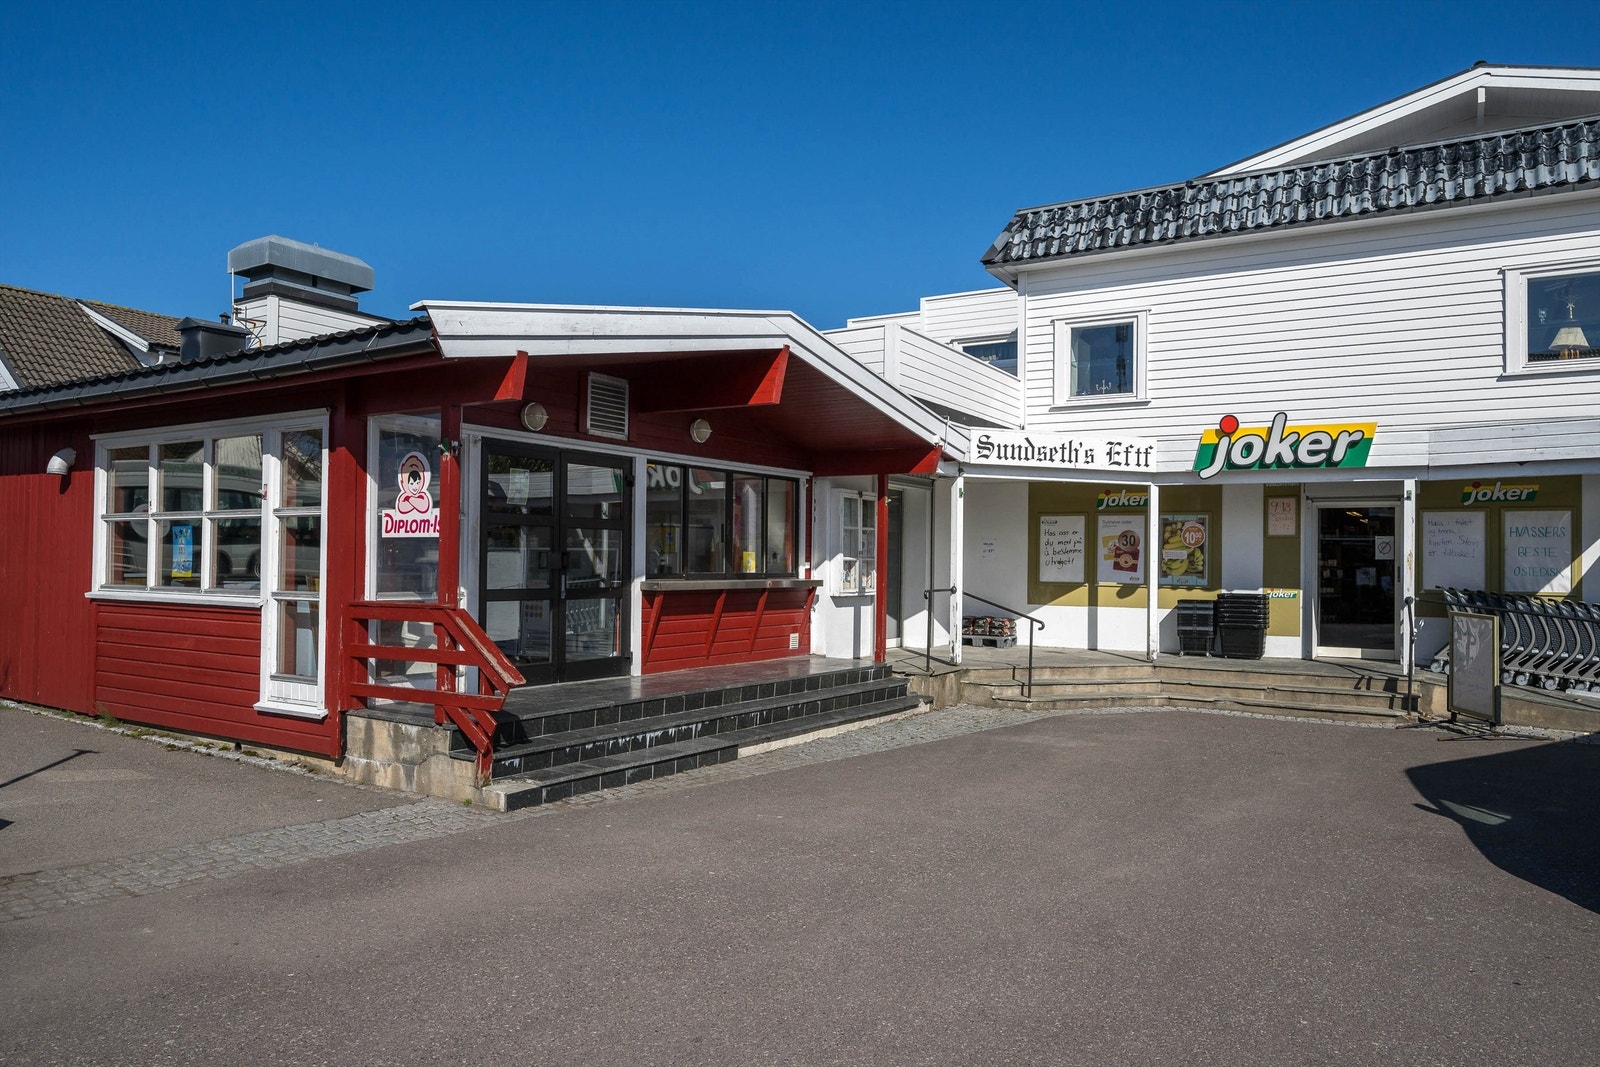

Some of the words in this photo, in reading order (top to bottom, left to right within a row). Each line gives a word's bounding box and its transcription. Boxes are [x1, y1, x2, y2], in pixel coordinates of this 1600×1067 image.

[976, 434, 1095, 468] Sundseth's
[1198, 412, 1365, 480] joker
[1098, 489, 1148, 510] joker
[1464, 481, 1535, 506] joker
[1122, 534, 1136, 547] 30
[1509, 526, 1566, 538] HVASSERS
[1517, 546, 1558, 558] BESTE
